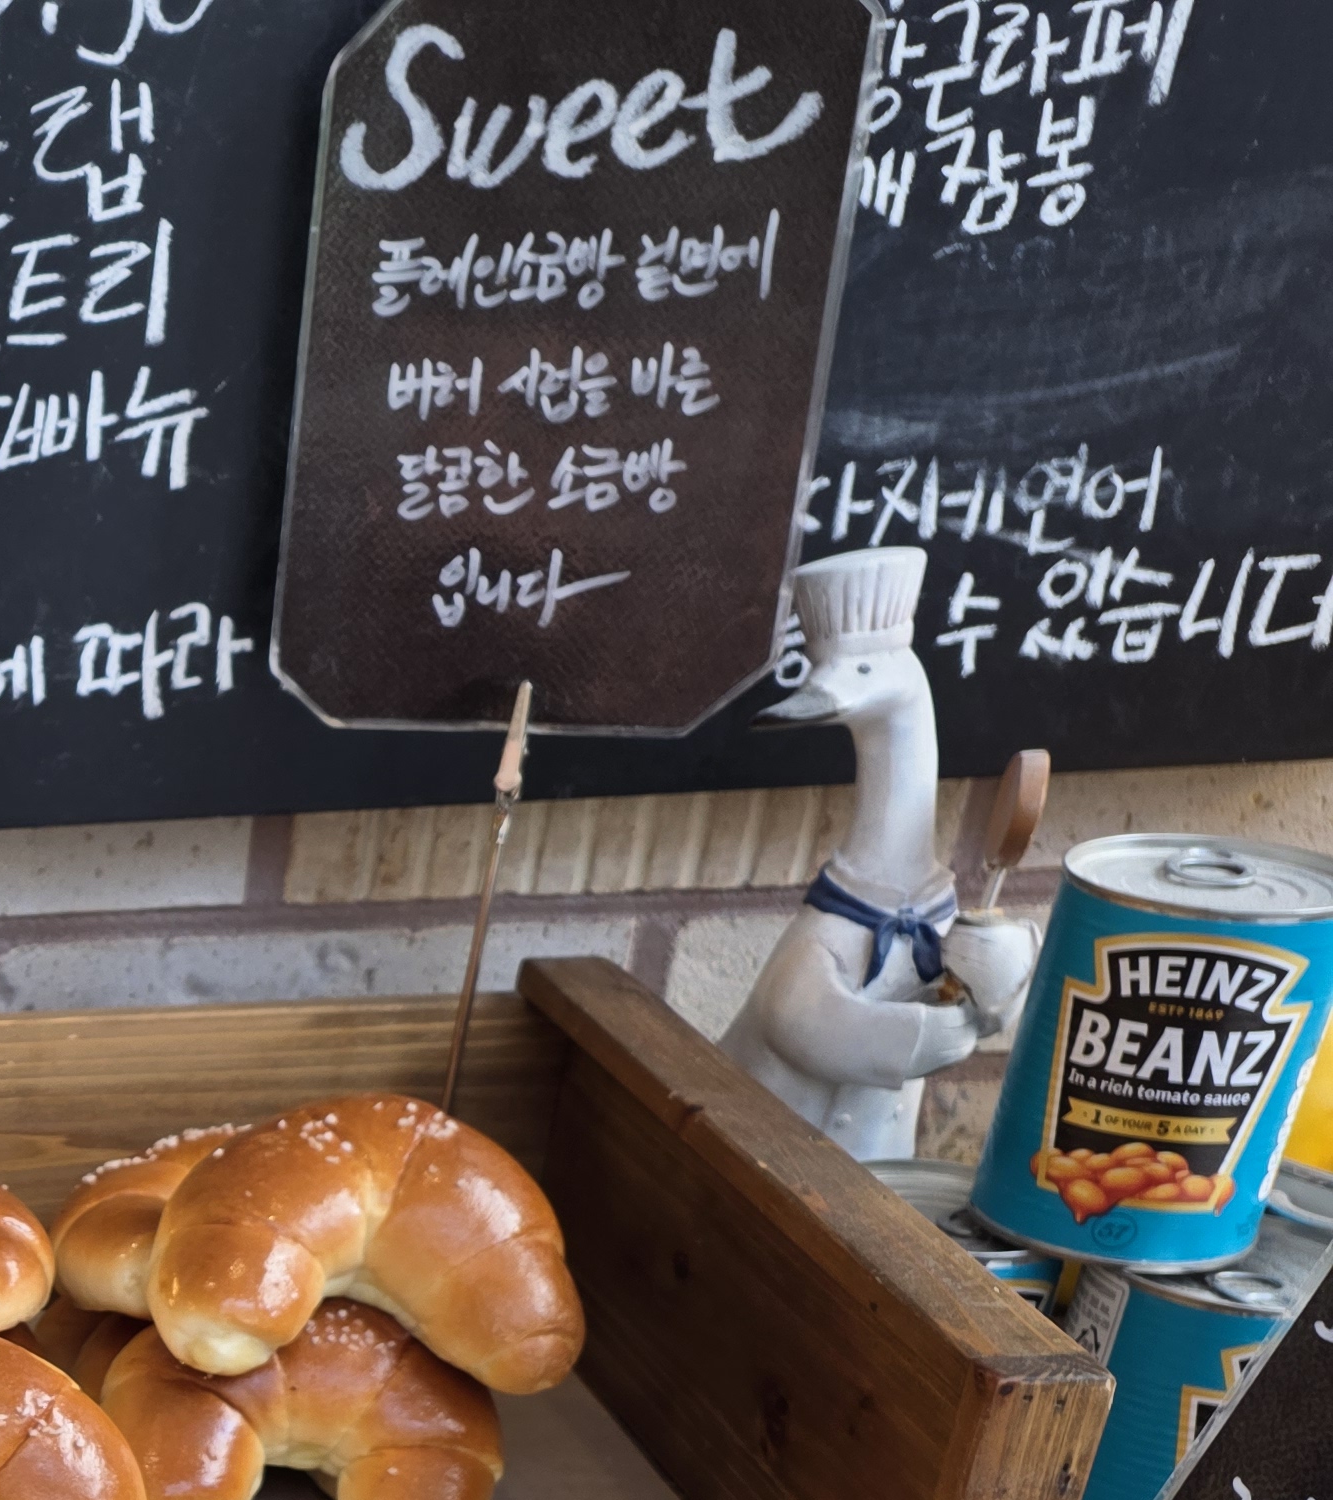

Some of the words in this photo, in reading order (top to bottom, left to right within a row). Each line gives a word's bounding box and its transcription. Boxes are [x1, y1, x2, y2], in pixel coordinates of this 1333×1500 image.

[339, 23, 824, 192] Sweet
[388, 356, 484, 422] 버터
[497, 344, 619, 424] 시럽을
[631, 340, 722, 417] 바른
[396, 438, 536, 522] 달콤한
[546, 437, 688, 514] 소금빵
[432, 546, 632, 629] 입니다
[935, 571, 1001, 678] 수
[1019, 546, 1333, 662] 있습니다
[73, 602, 254, 720] 따라
[1118, 955, 1278, 1013] HEINZ
[1067, 1067, 1085, 1086] In
[1087, 1077, 1097, 1091] a
[1099, 1077, 1134, 1097] rich
[1137, 1084, 1201, 1106] tomato
[1203, 1091, 1251, 1107] sauce
[1068, 1008, 1277, 1088] BEANZ
[1156, 1119, 1172, 1136] 5
